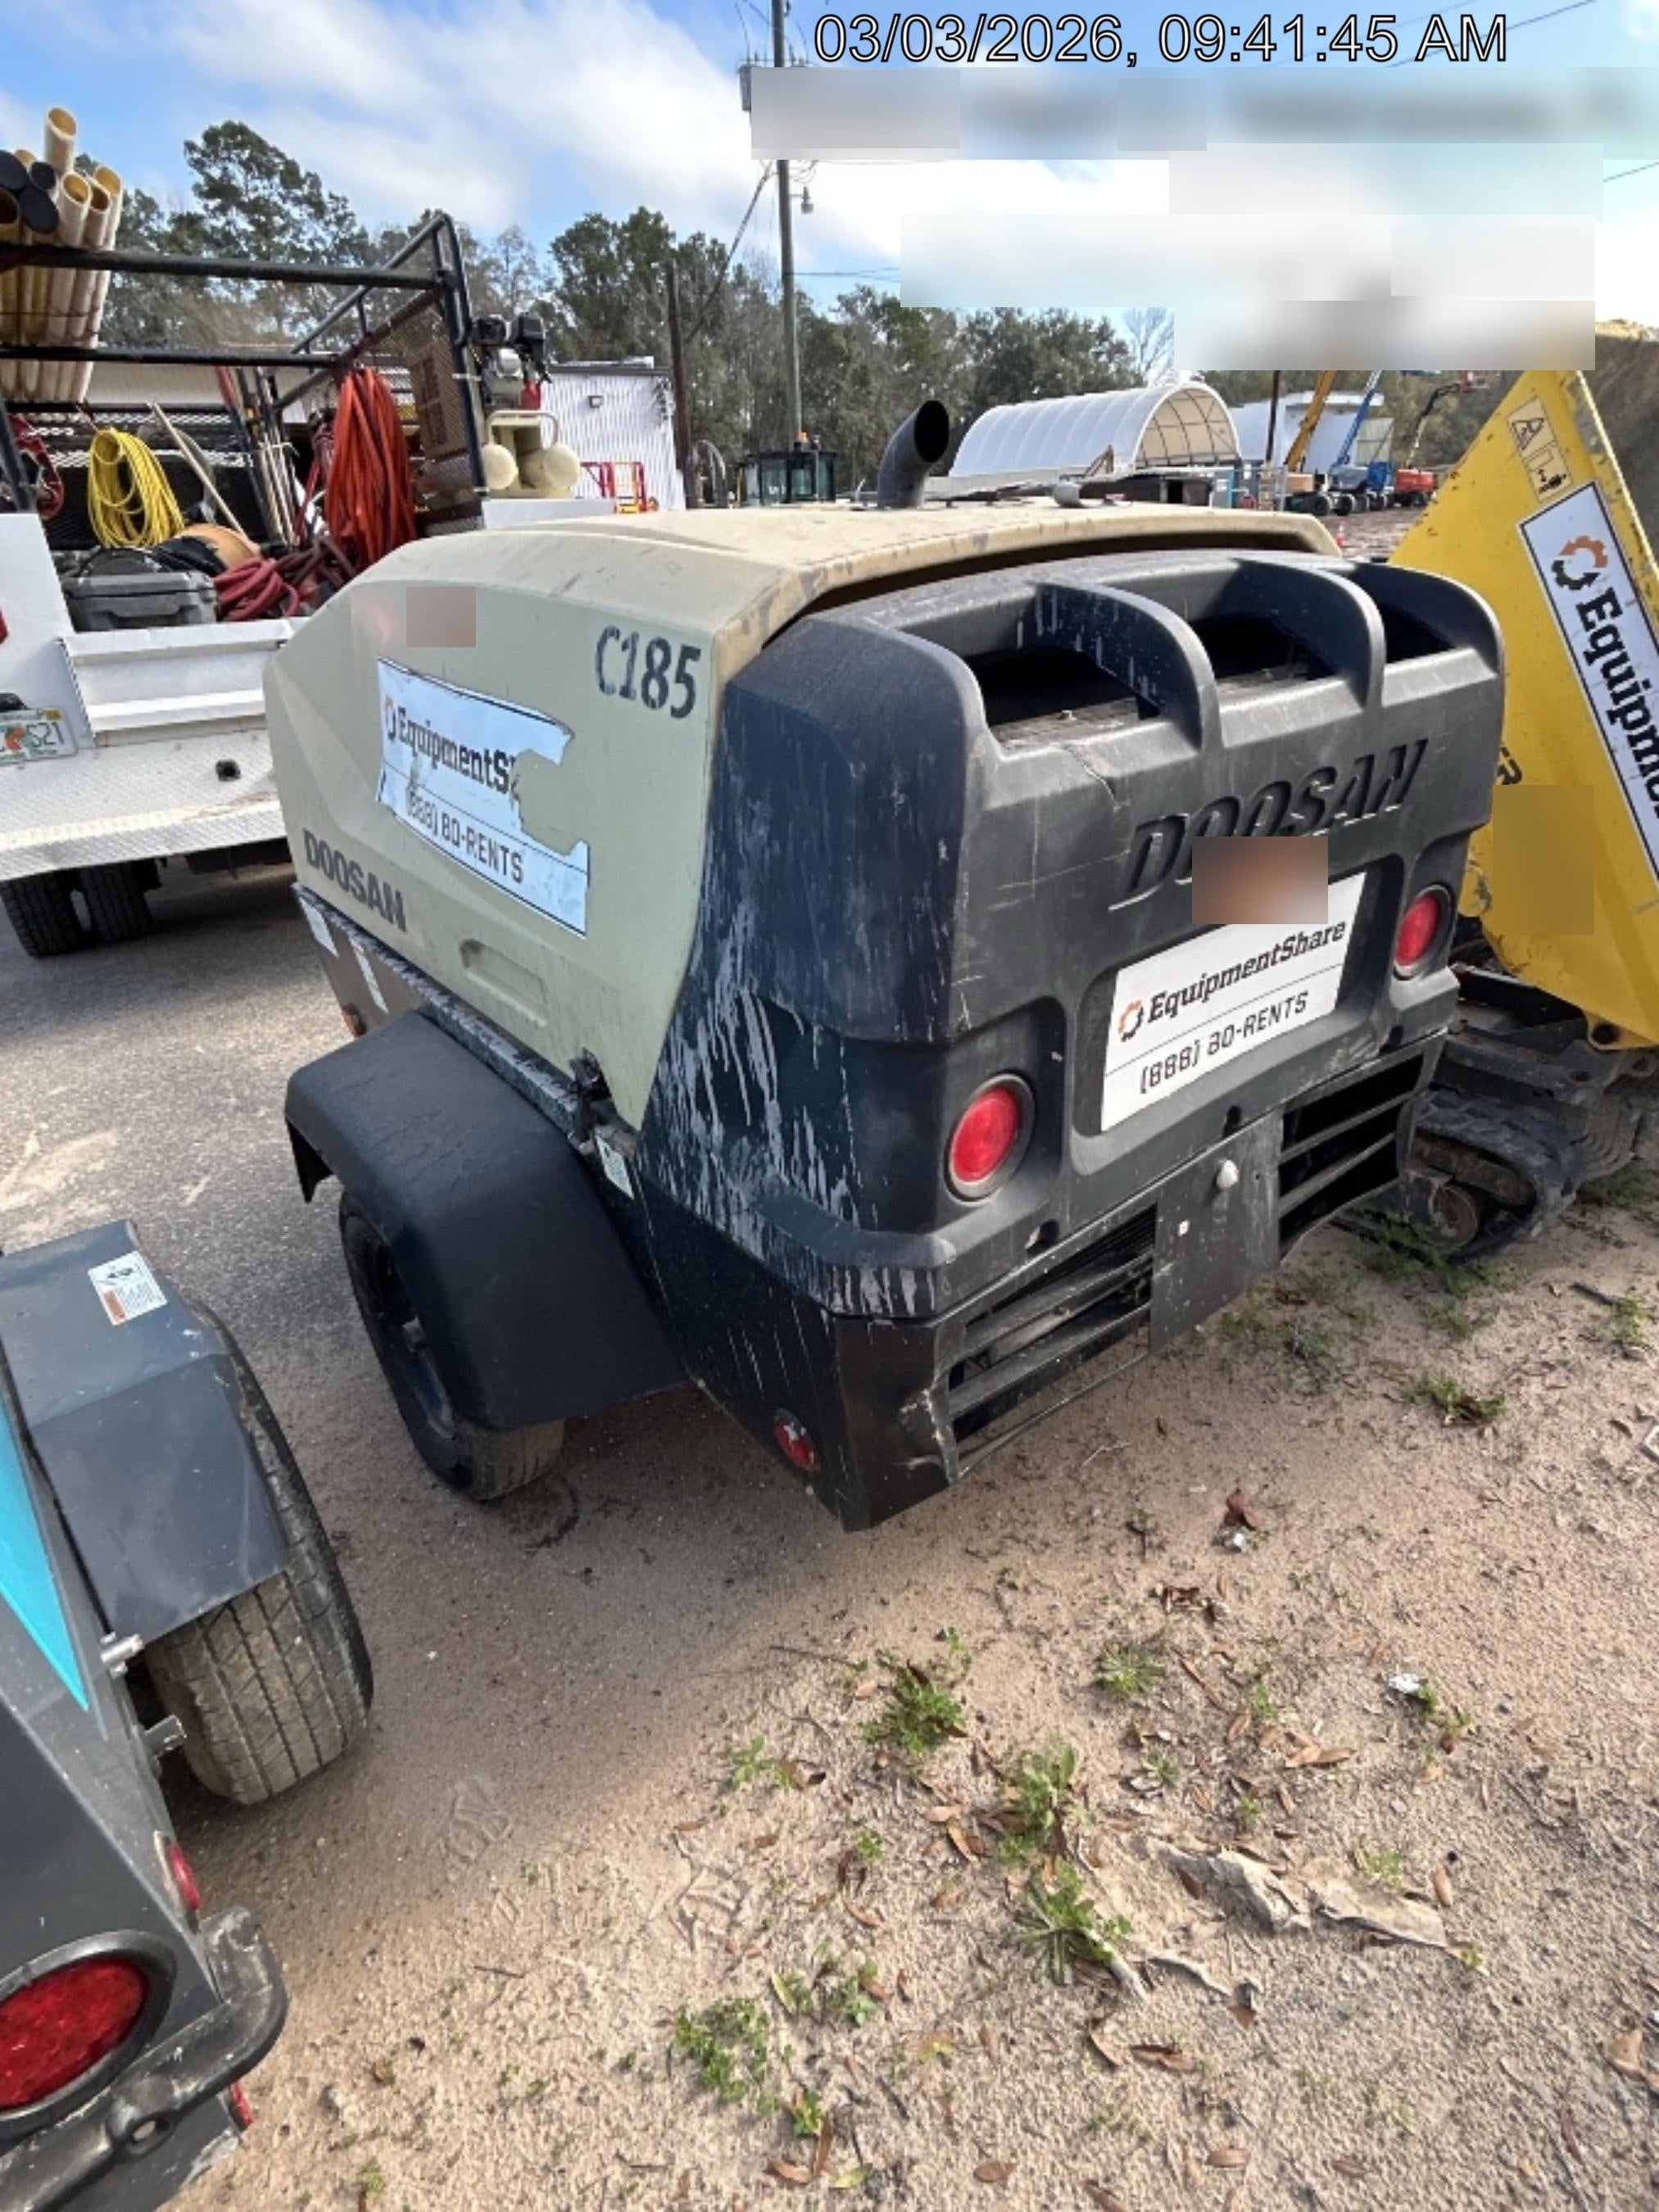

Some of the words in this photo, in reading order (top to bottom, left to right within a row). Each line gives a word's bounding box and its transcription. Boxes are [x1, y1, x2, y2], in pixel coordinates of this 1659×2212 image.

[595, 623, 702, 719] C185
[397, 706, 518, 795] EquipmentS
[1108, 738, 1429, 913] DOOSAN
[302, 827, 407, 932] DOOSAN
[1147, 921, 1347, 1024] EquipmentShare
[1139, 1040, 1201, 1095] (888)
[1206, 990, 1309, 1056] 80-RENTS
